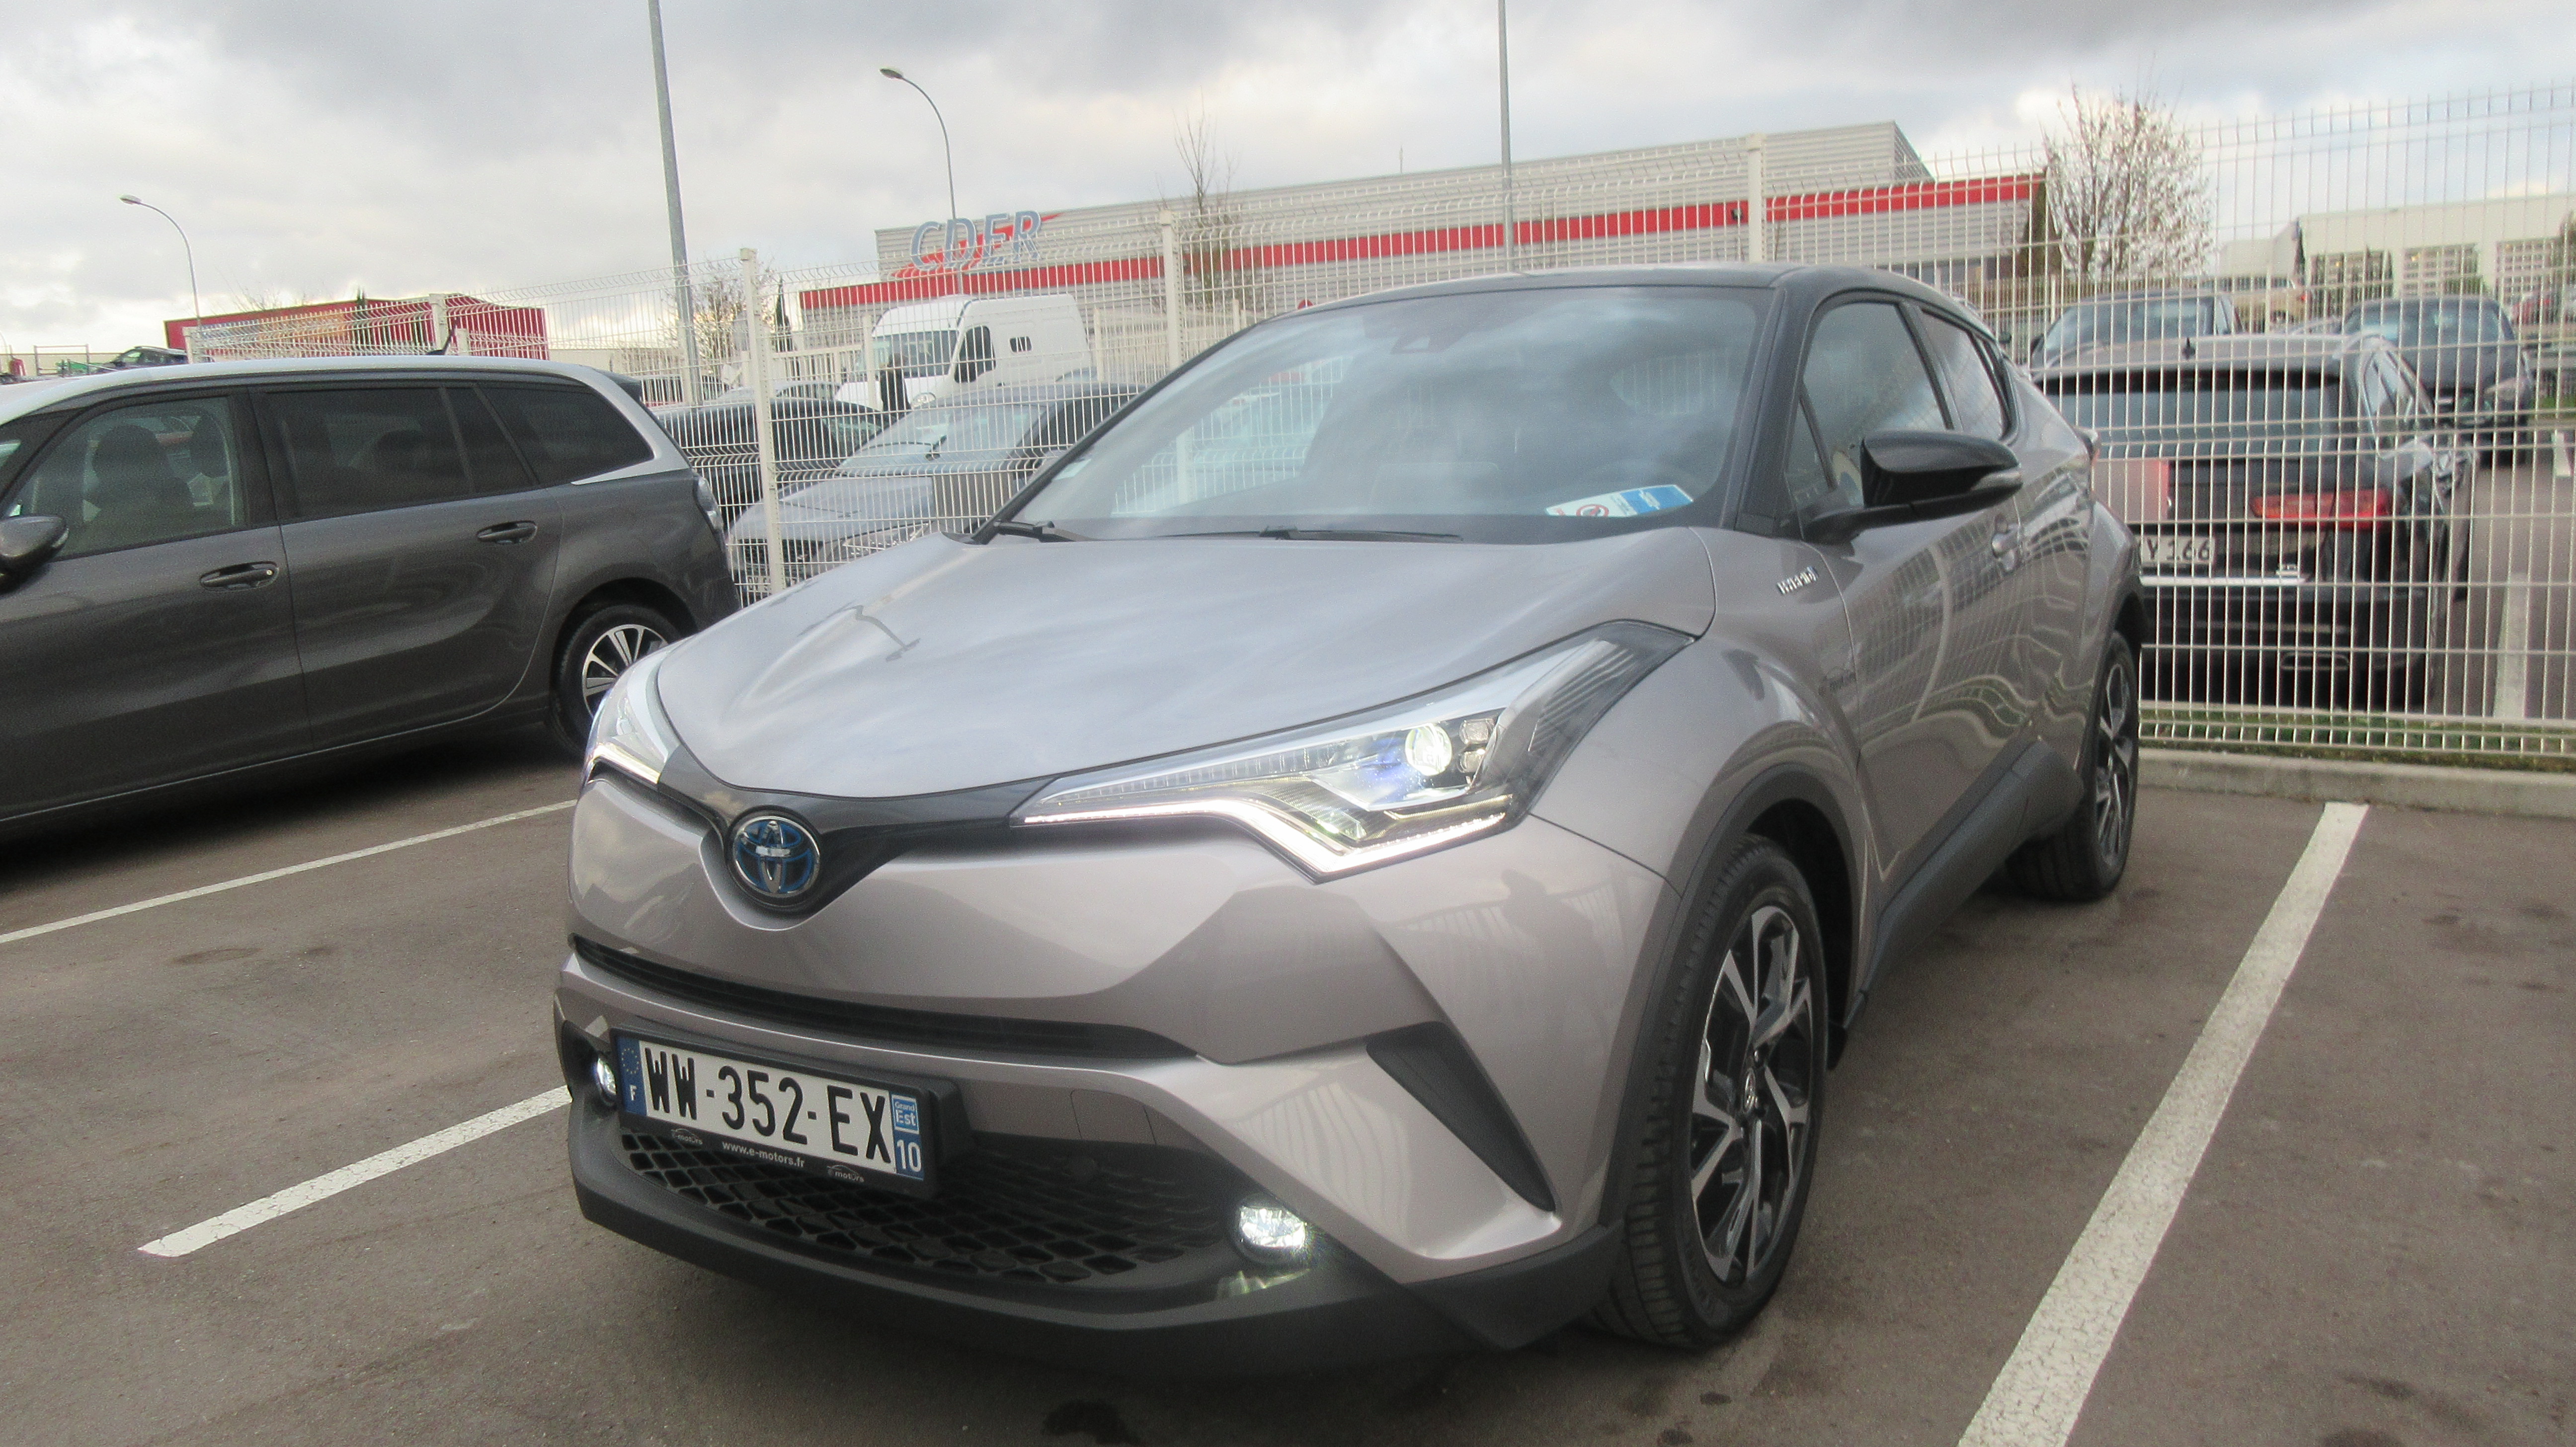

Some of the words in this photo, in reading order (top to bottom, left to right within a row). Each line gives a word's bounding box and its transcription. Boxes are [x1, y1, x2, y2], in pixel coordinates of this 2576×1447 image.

[910, 210, 1041, 271] CDER
[629, 1084, 638, 1101] F
[644, 1047, 891, 1163] WW-352-EX
[895, 1101, 915, 1111] Grand
[895, 1109, 916, 1126] Est
[722, 1141, 805, 1168] www.e-motors.fr
[896, 1139, 922, 1173] 10
